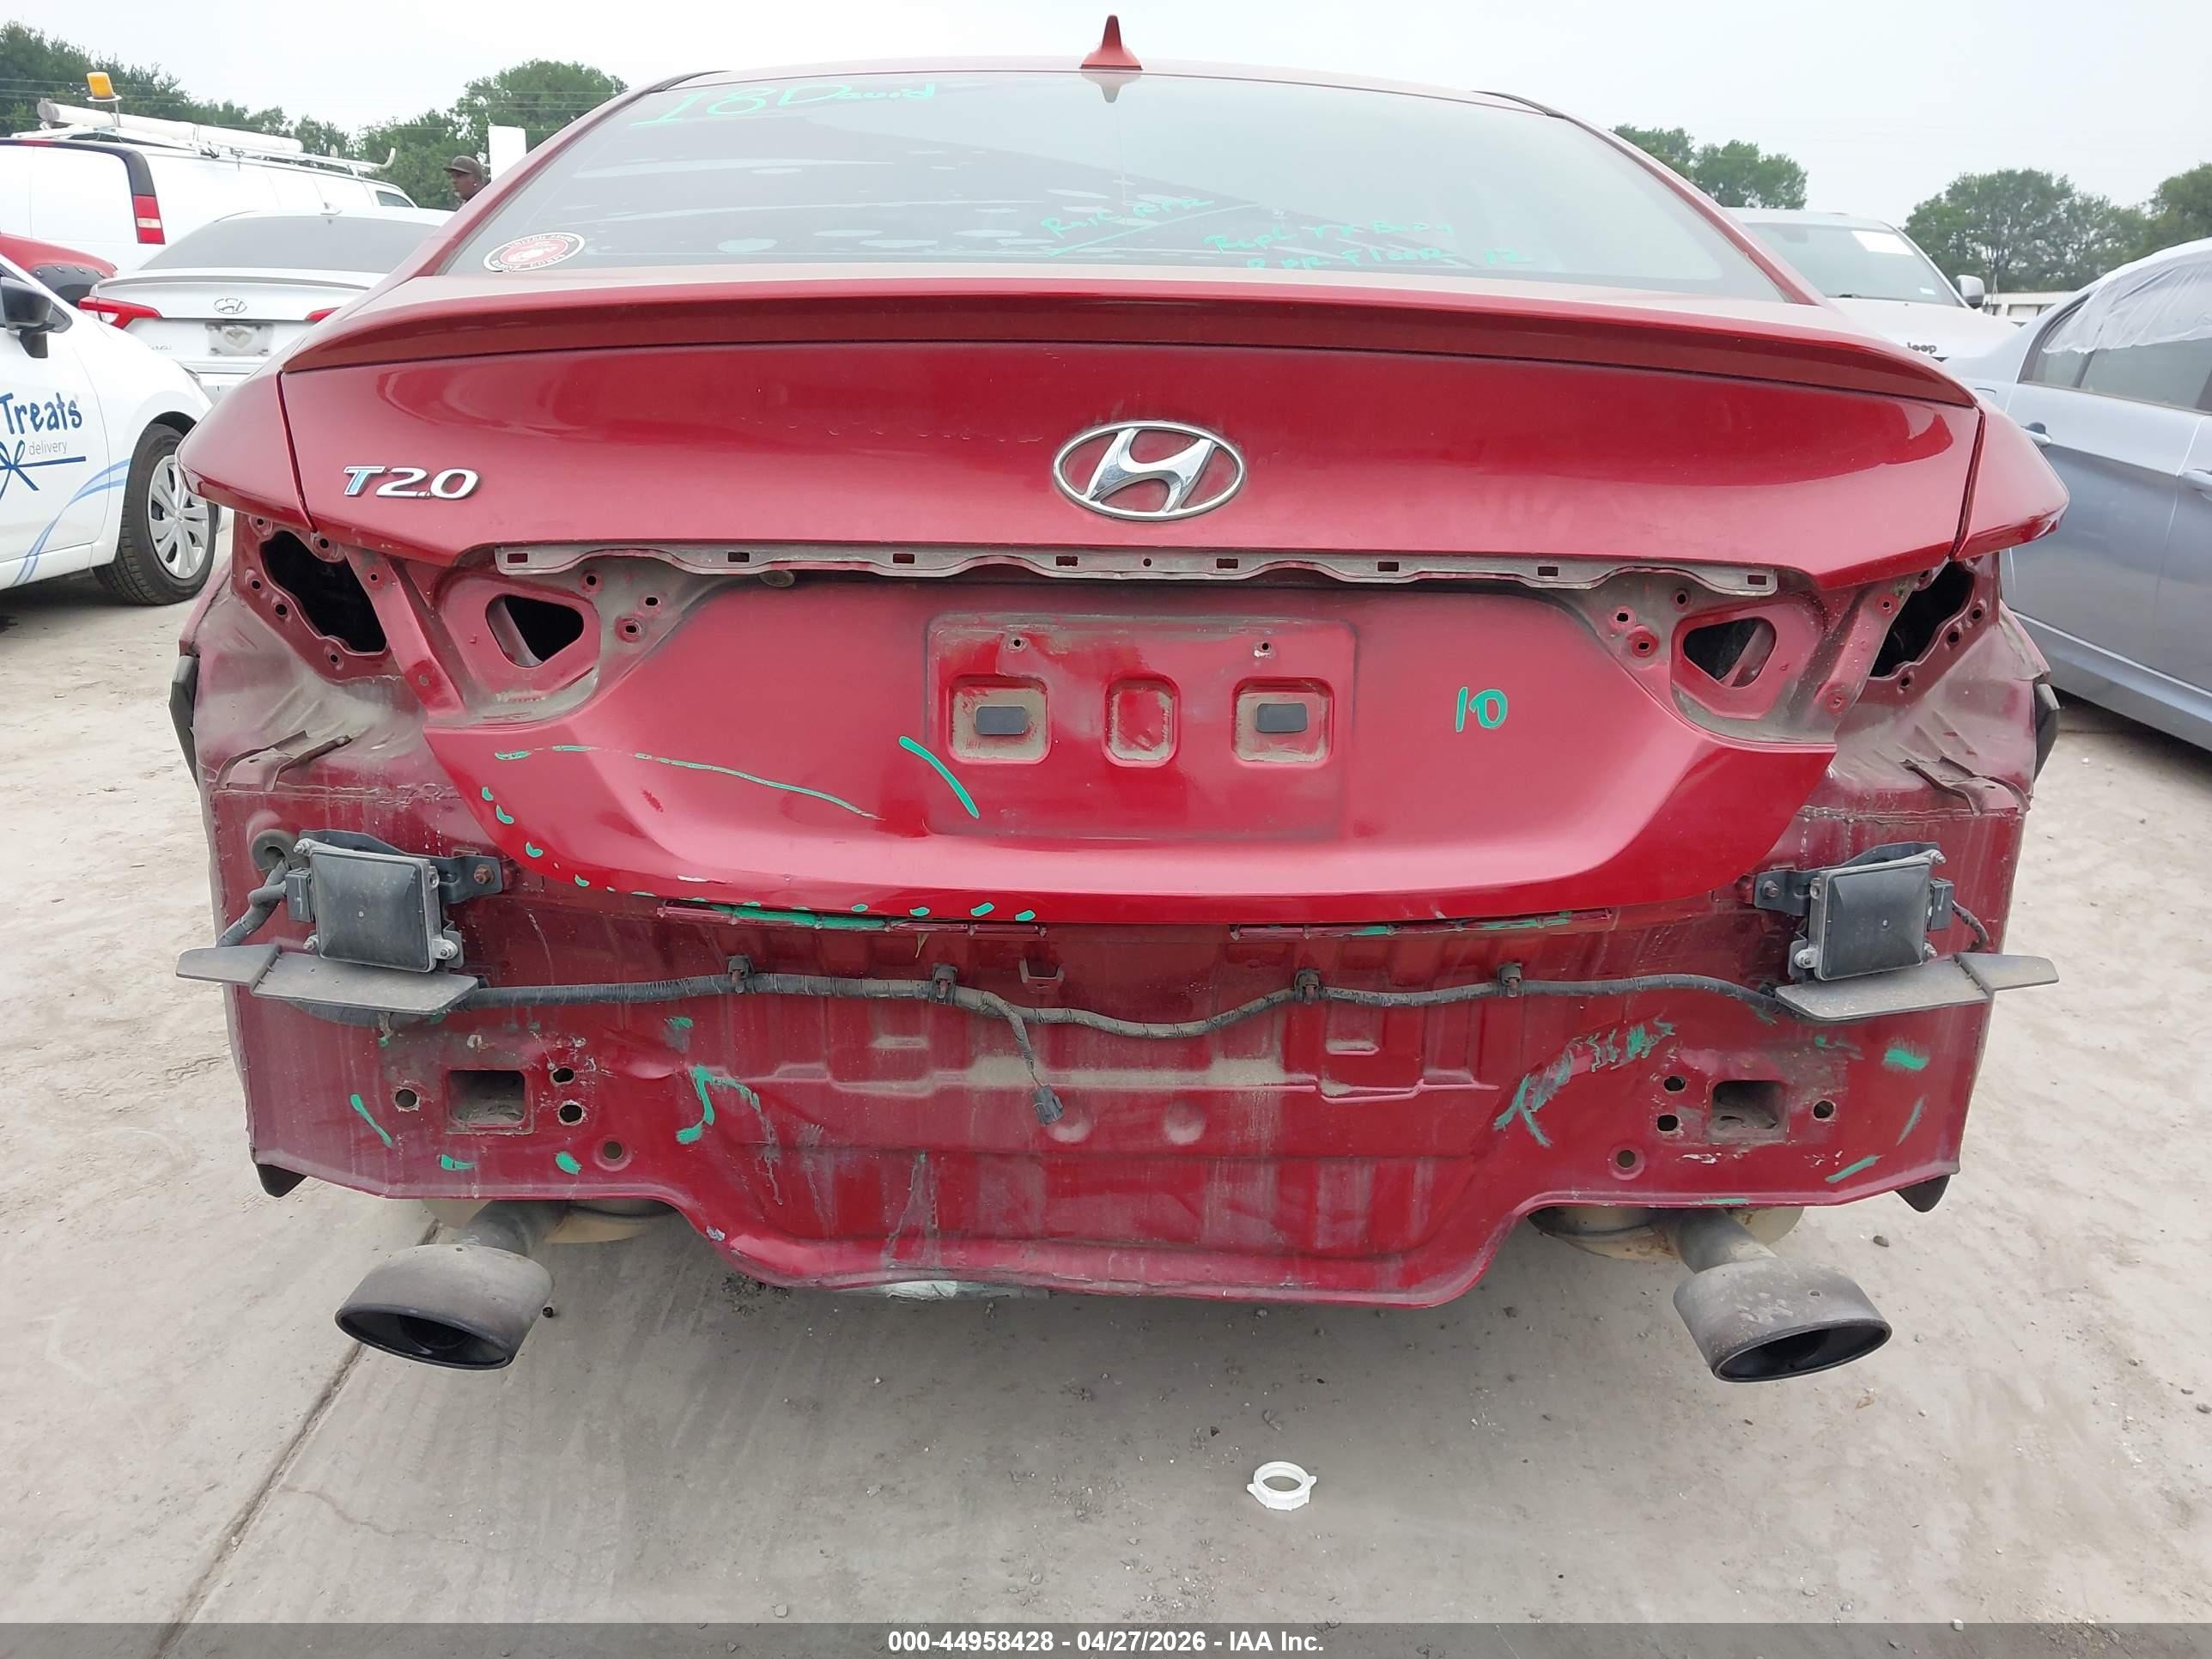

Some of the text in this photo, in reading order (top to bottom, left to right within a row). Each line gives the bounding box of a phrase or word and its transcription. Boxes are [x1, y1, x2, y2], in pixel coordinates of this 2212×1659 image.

[0, 392, 82, 434] Treats
[28, 439, 68, 456] delivery
[1455, 686, 1509, 733] 10
